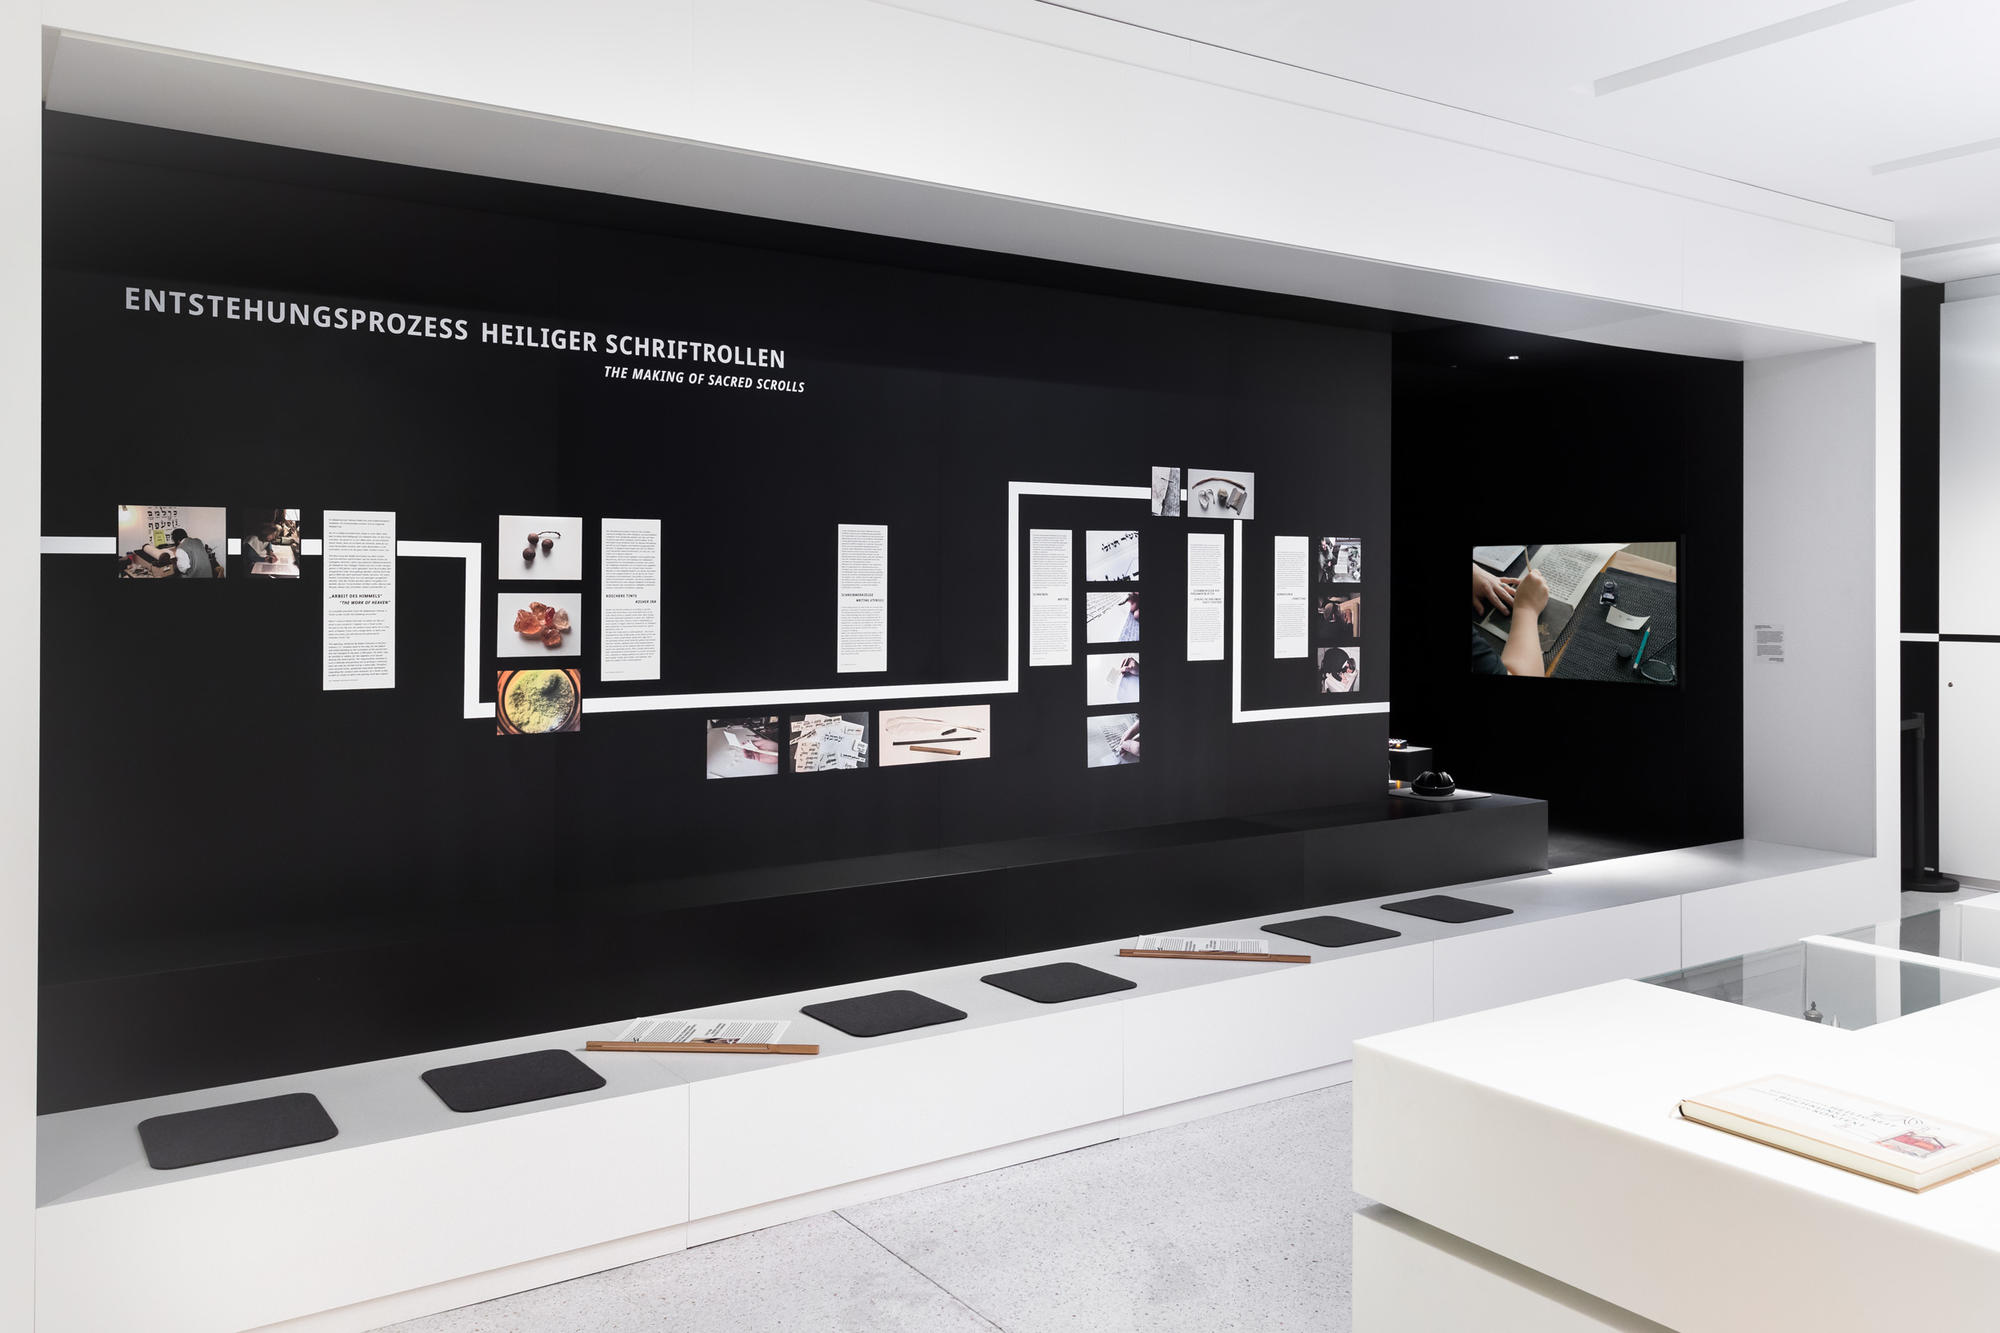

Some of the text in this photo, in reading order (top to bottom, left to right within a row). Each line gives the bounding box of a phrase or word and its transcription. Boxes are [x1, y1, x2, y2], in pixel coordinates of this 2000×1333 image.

[125, 286, 785, 369] ENTSTEHUNGSPROZESS HEILIGER SCHRIFTROLLEN
[604, 366, 805, 393] THE MAKING OF SACRED SCROLLS
